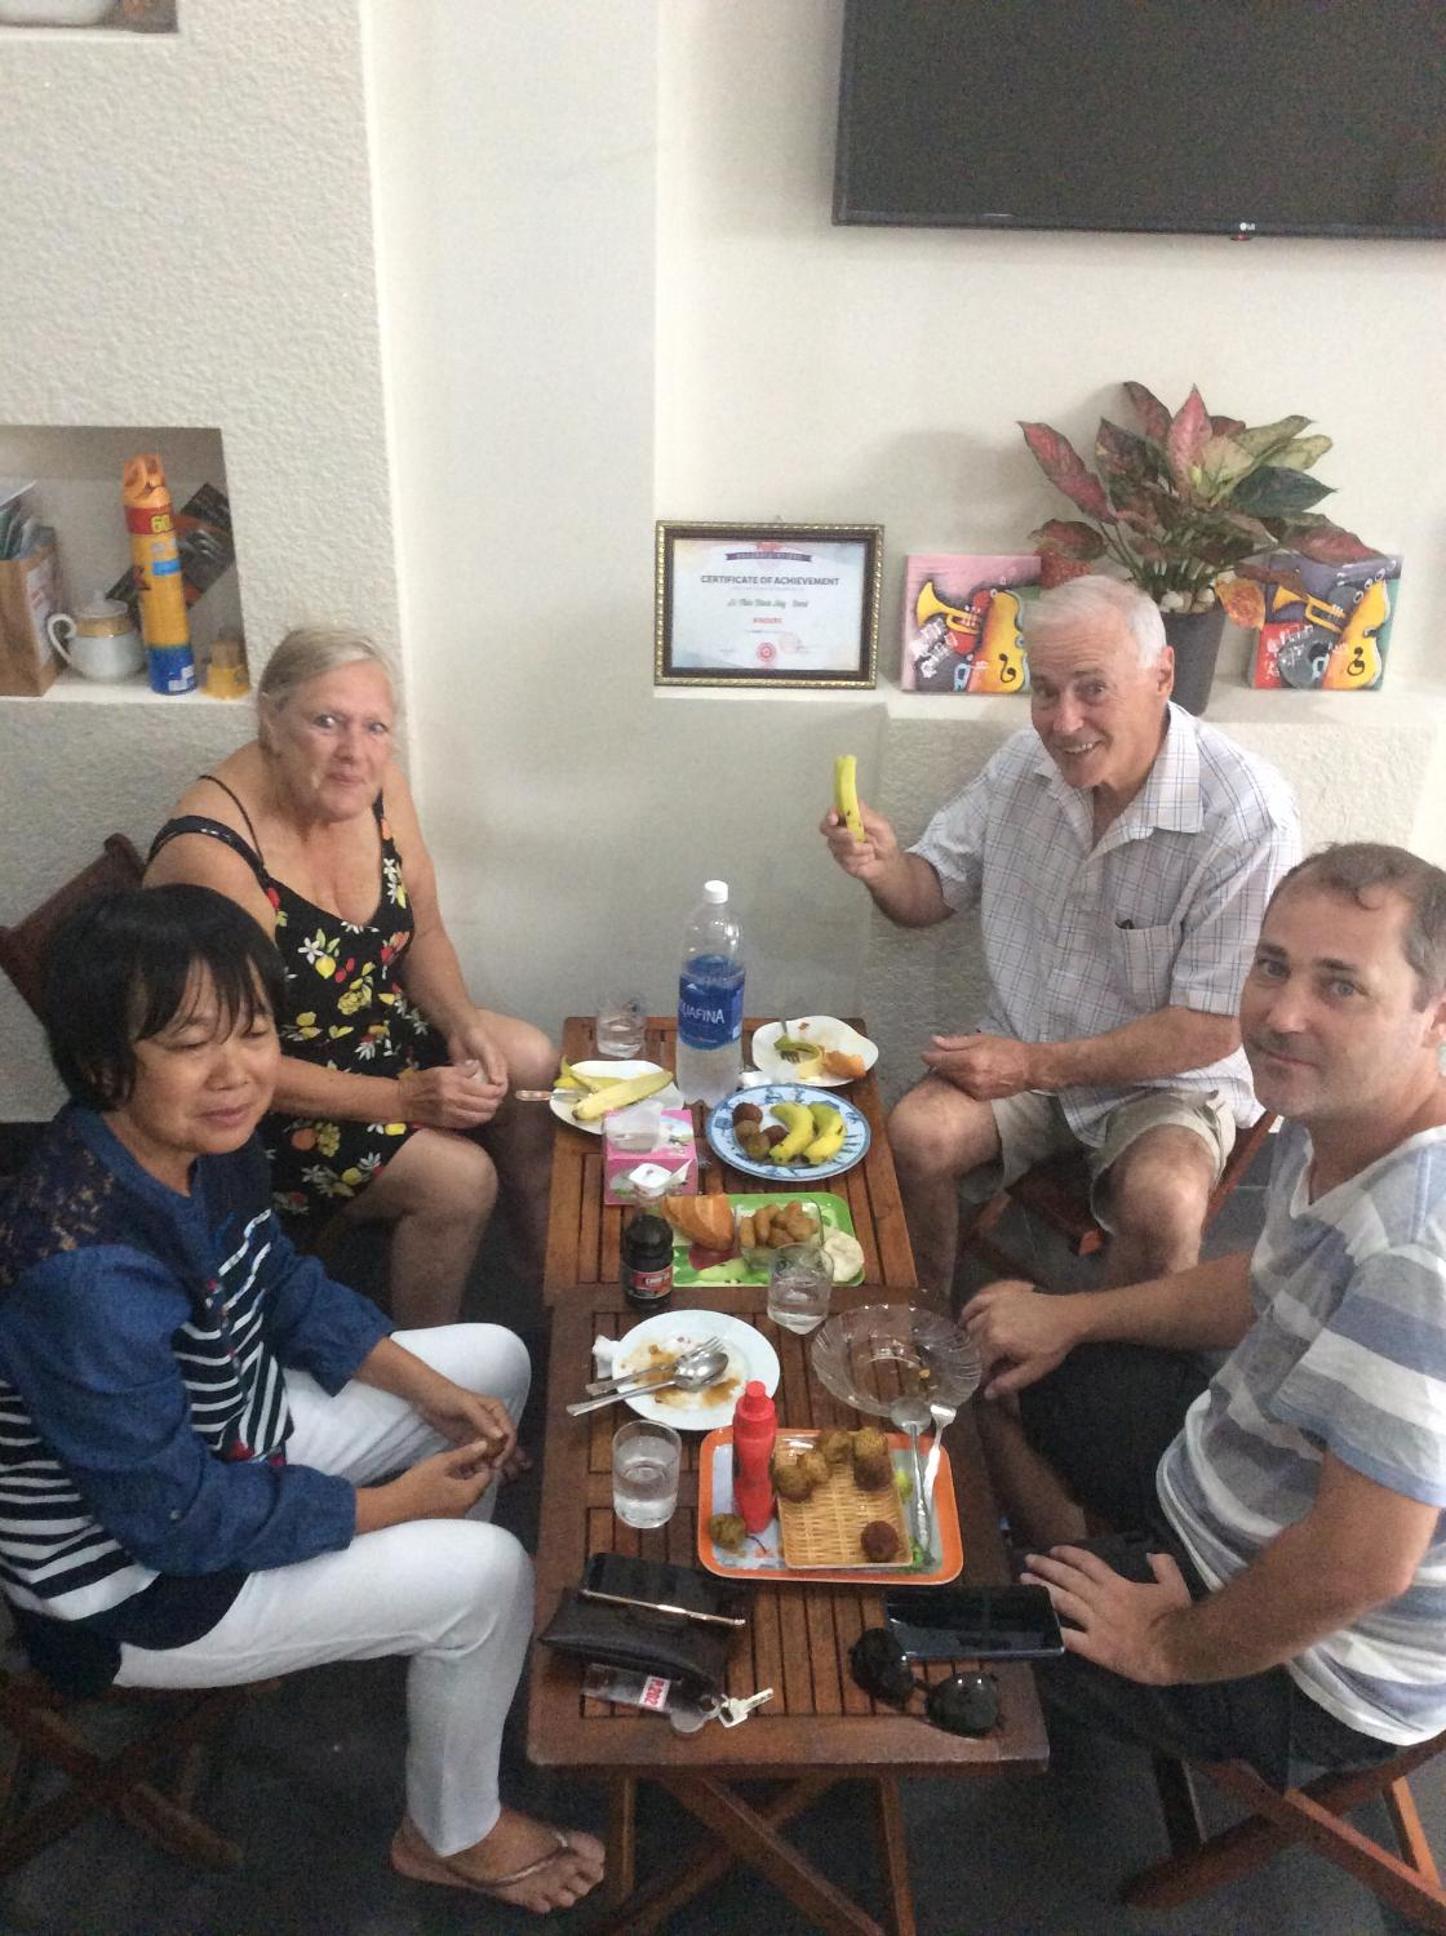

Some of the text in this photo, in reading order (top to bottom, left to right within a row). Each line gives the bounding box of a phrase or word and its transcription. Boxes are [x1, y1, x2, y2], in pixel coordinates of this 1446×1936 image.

[700, 575, 840, 586] CERTIFICATE OF ACHIEVEMENT
